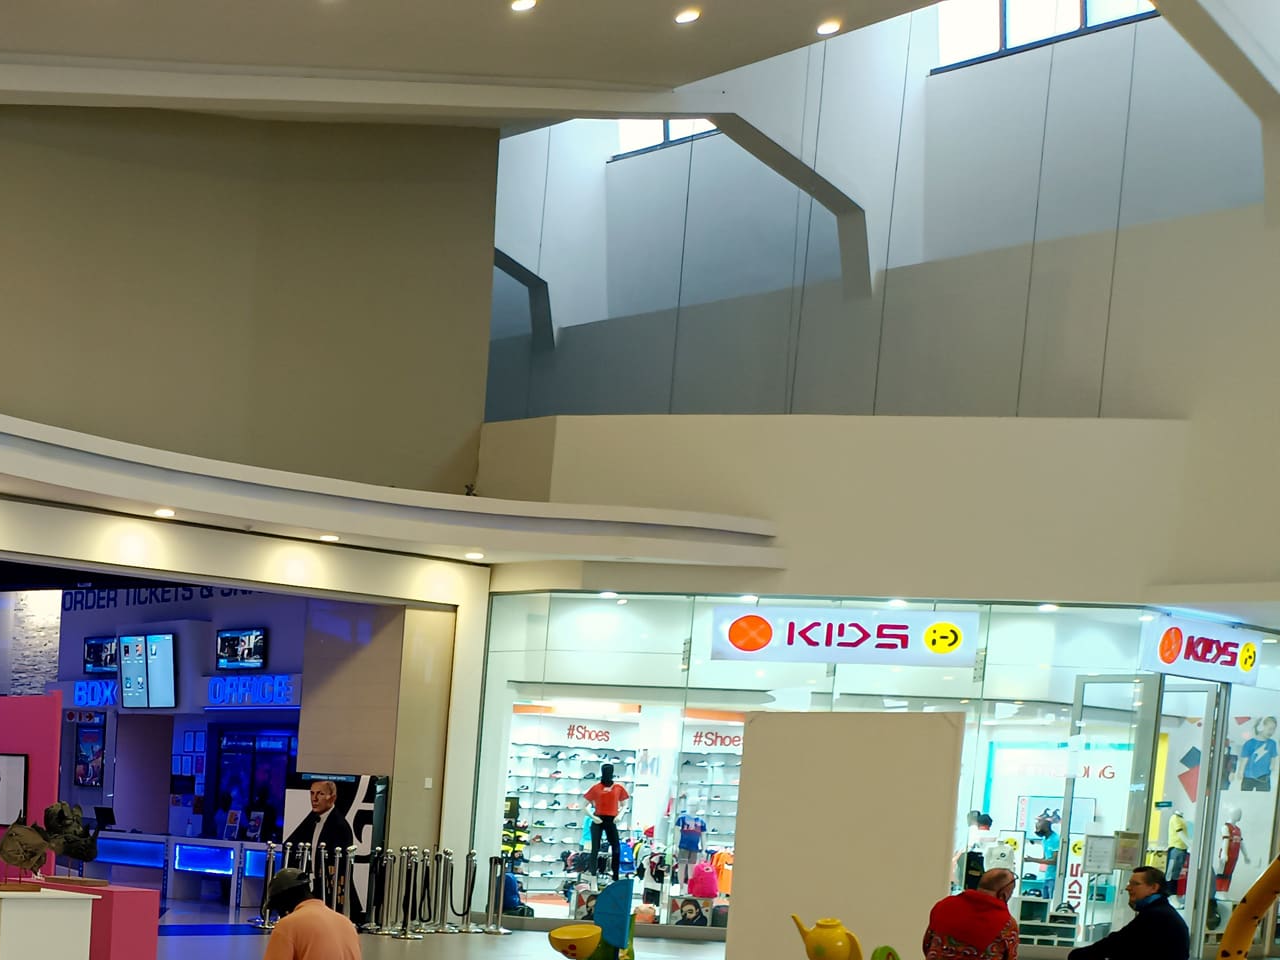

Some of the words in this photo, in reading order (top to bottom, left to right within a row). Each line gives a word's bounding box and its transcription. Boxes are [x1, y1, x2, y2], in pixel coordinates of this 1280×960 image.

[62, 589, 117, 611] ORDER
[124, 586, 193, 606] TICKETS
[786, 620, 910, 650] KIDS
[1183, 636, 1240, 667] KIDS
[567, 724, 610, 742] #Shoes
[692, 731, 744, 747] #Shoe
